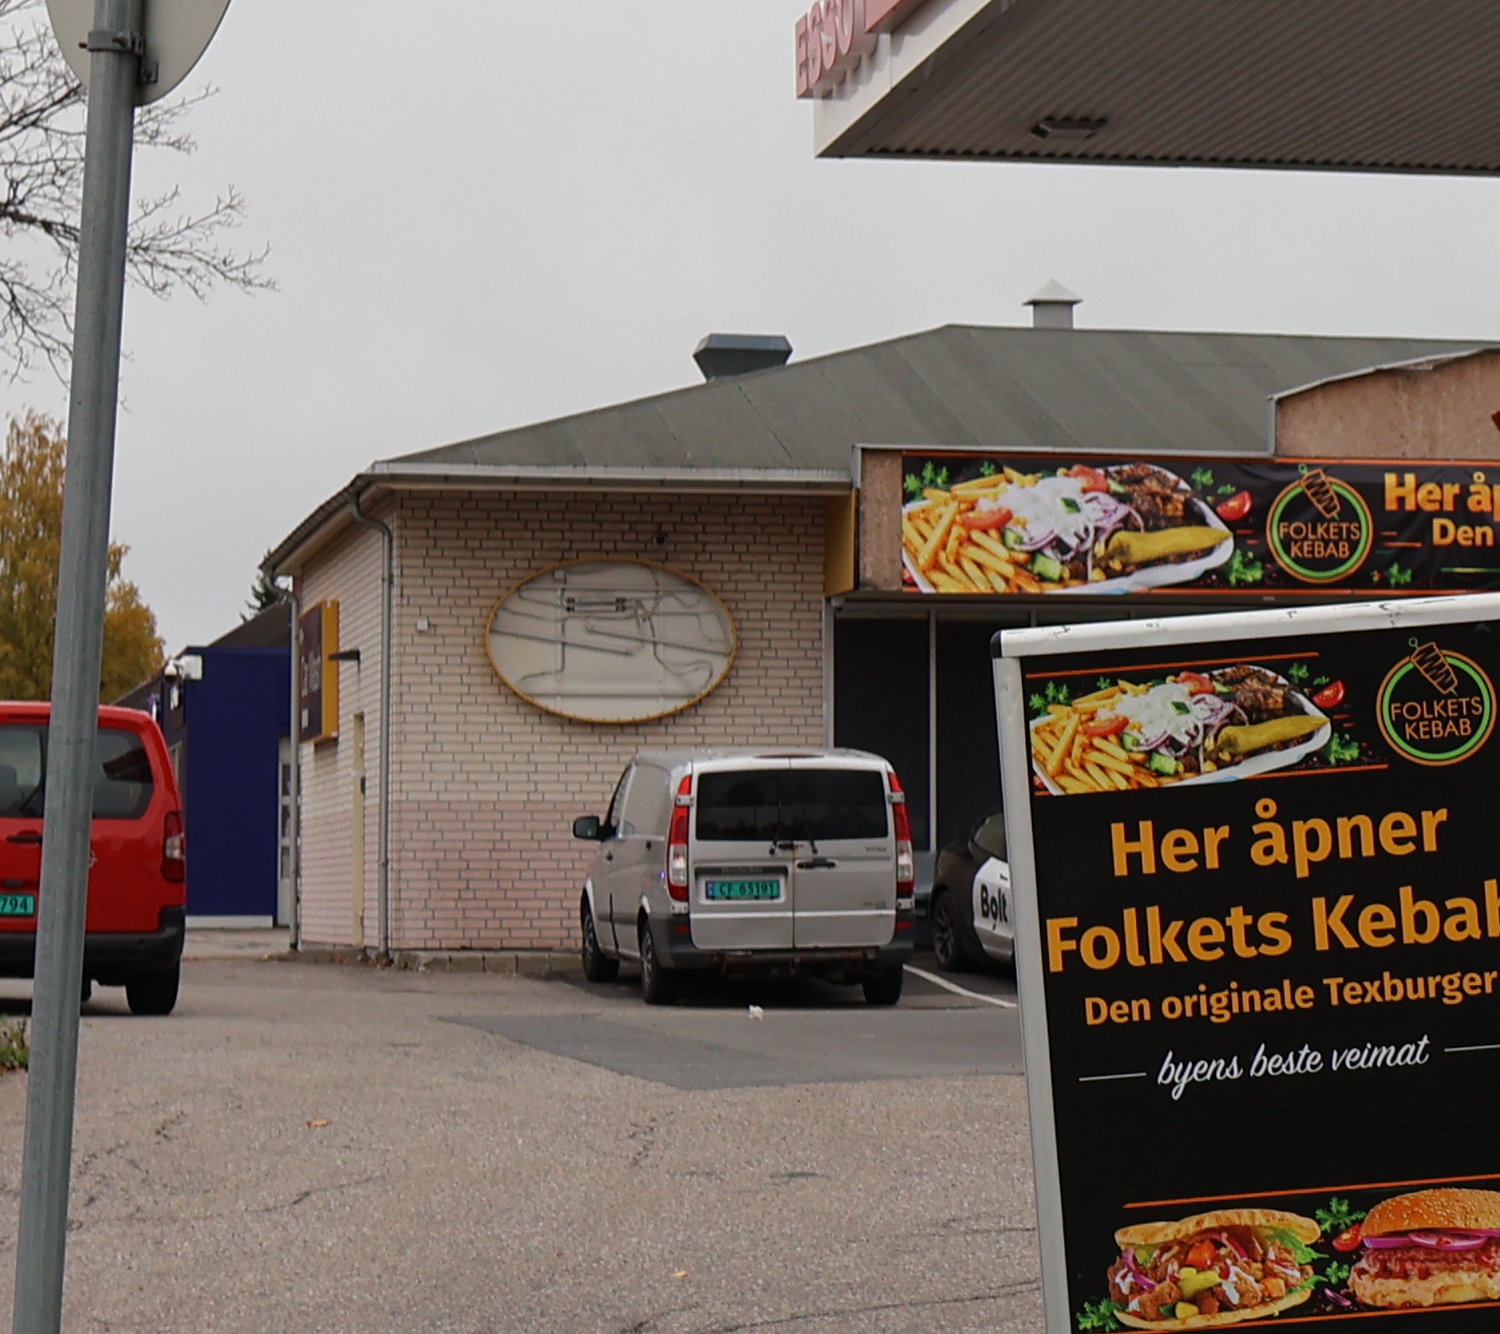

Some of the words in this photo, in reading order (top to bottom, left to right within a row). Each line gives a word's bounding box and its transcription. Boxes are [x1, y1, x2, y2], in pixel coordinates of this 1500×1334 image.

[1384, 472, 1461, 512] Her
[1279, 521, 1360, 541] FOLKETS
[1432, 518, 1493, 547] Den
[1290, 540, 1350, 559] KEBAB
[1391, 695, 1483, 722] FOLKETS
[1405, 717, 1472, 741] KEBAB
[1110, 818, 1230, 877] Her
[1250, 798, 1448, 878] åpner
[719, 883, 735, 896] CF
[981, 883, 1008, 923] Bolt
[1046, 904, 1293, 973] Folkets
[1085, 993, 1151, 1026] Den
[1161, 978, 1315, 1023] originale
[1322, 966, 1498, 1006] Texburger
[1157, 1049, 1243, 1100] byens
[1250, 1043, 1324, 1079] beste
[1331, 1034, 1431, 1071] veimat
